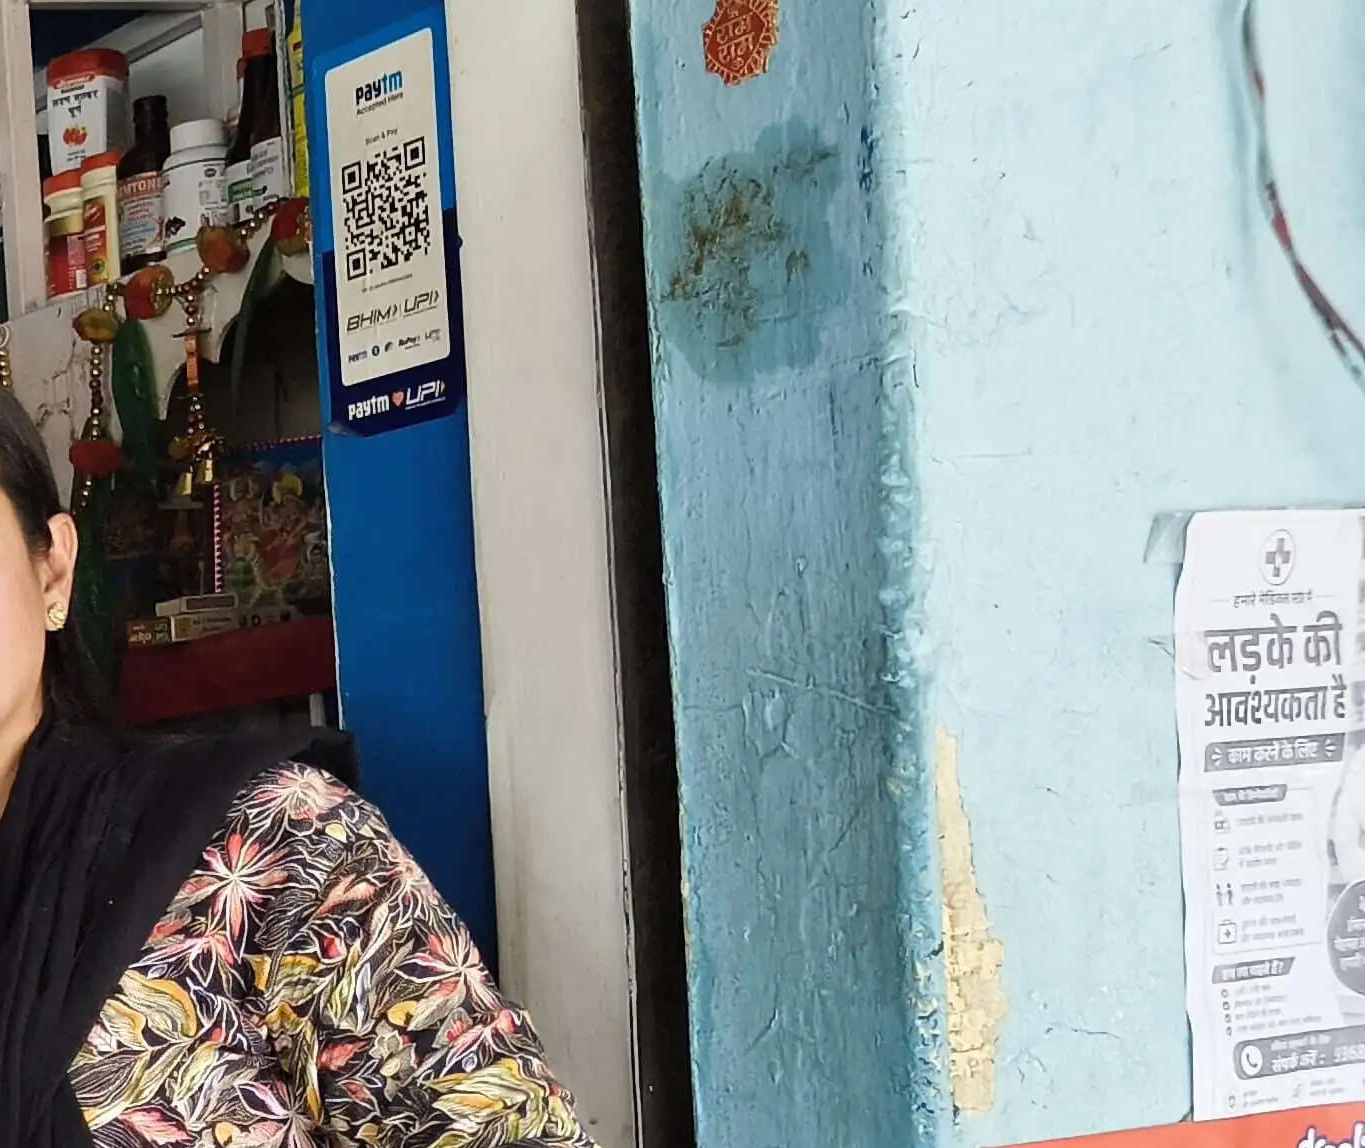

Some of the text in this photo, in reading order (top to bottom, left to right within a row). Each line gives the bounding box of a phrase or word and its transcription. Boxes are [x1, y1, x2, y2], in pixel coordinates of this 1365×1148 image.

[348, 394, 390, 421] paytm
[1204, 610, 1343, 684] लड़के की
[1204, 673, 1348, 727] आवश्यकता है
